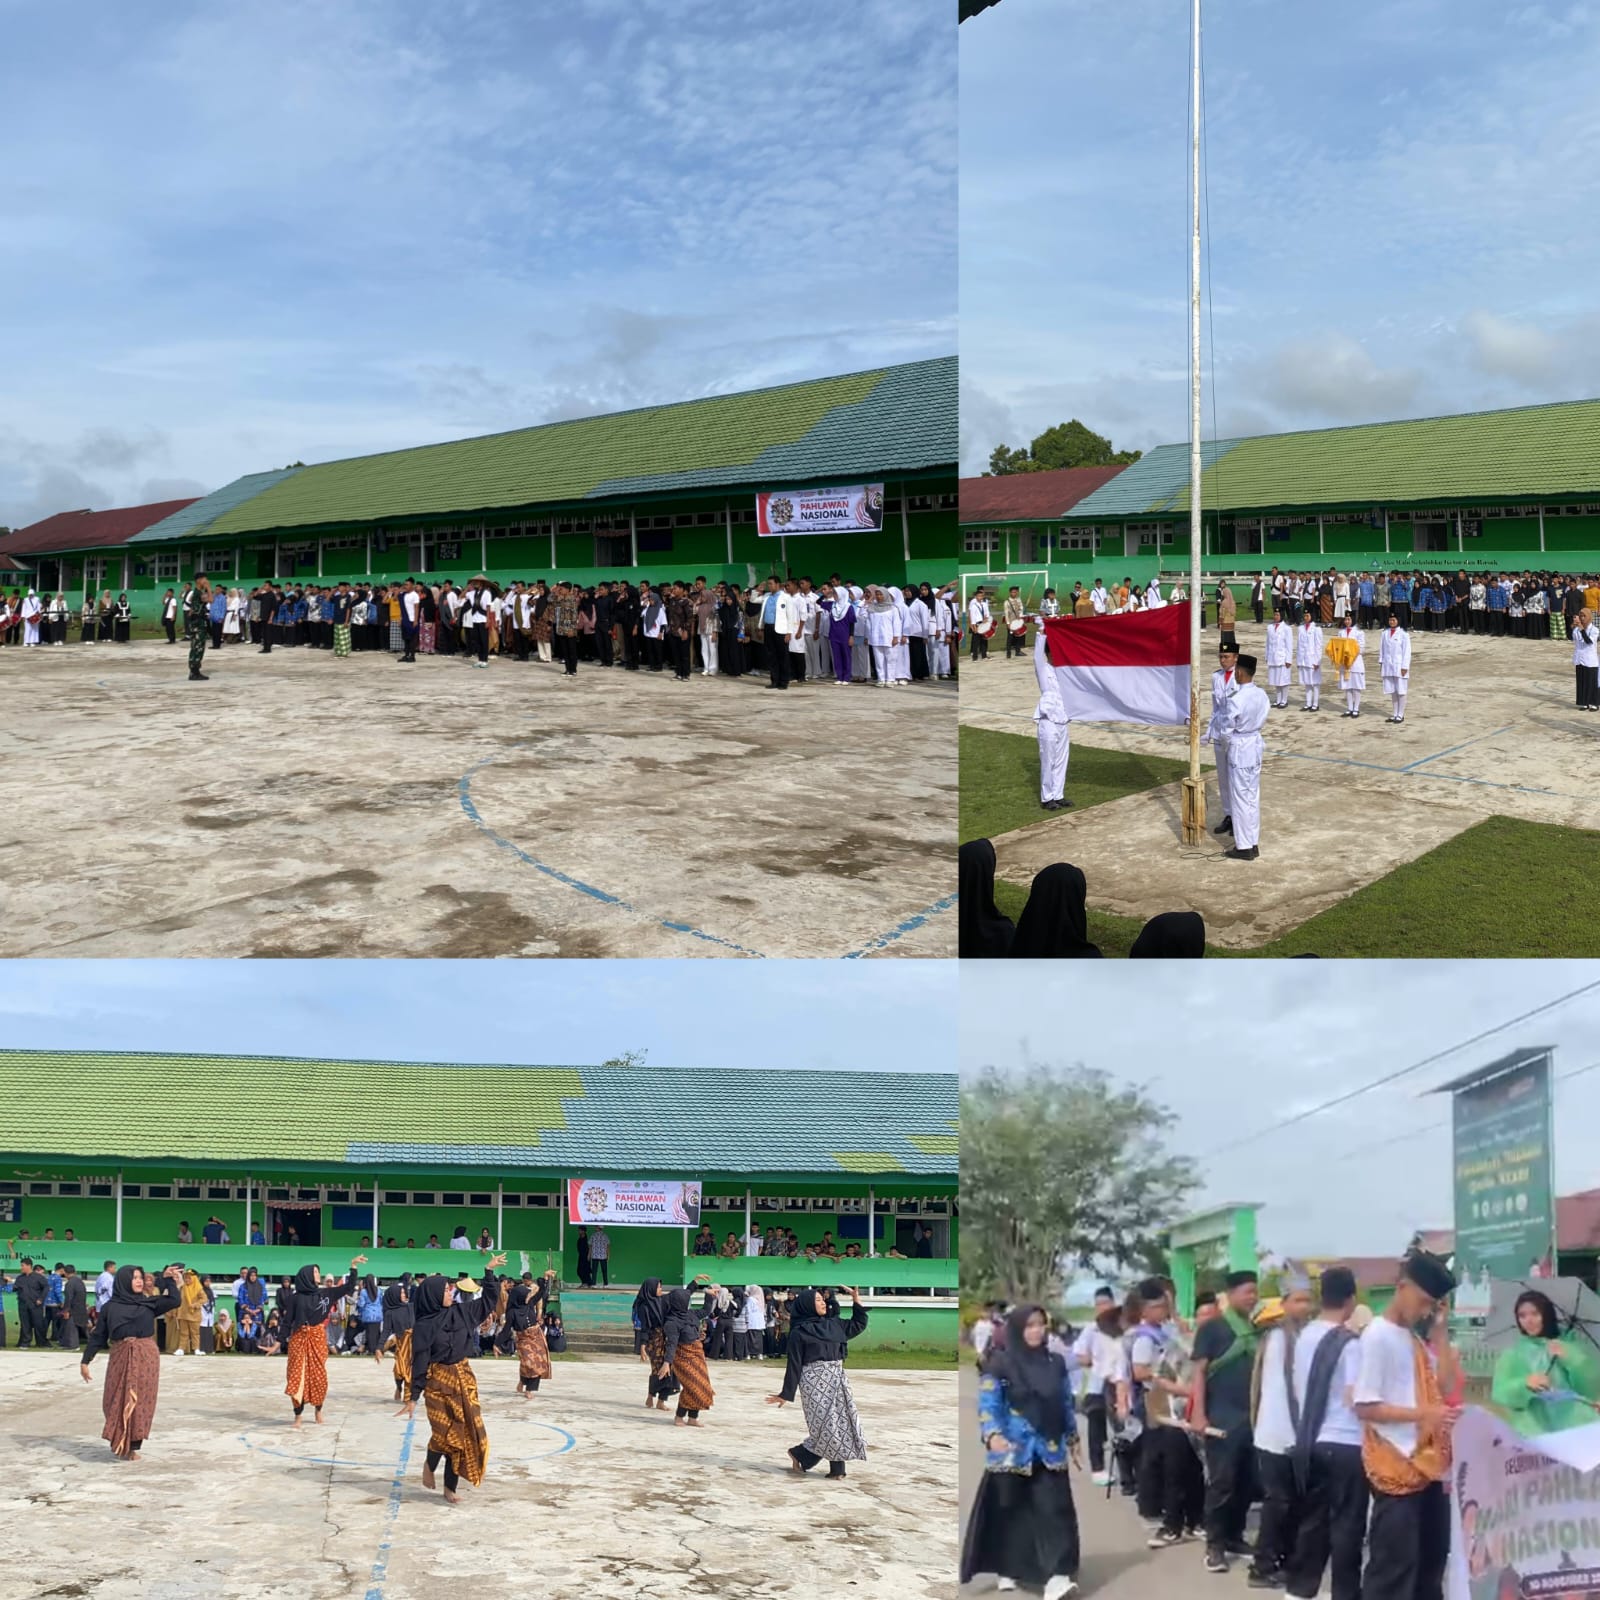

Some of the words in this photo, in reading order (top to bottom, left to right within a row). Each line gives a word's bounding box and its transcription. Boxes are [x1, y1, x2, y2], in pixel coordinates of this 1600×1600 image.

[800, 501, 849, 510] PAHLAWAN
[800, 509, 849, 520] NASIONAL
[615, 1194, 666, 1203] PAHLAWAN
[615, 1203, 666, 1212] NASIONAL
